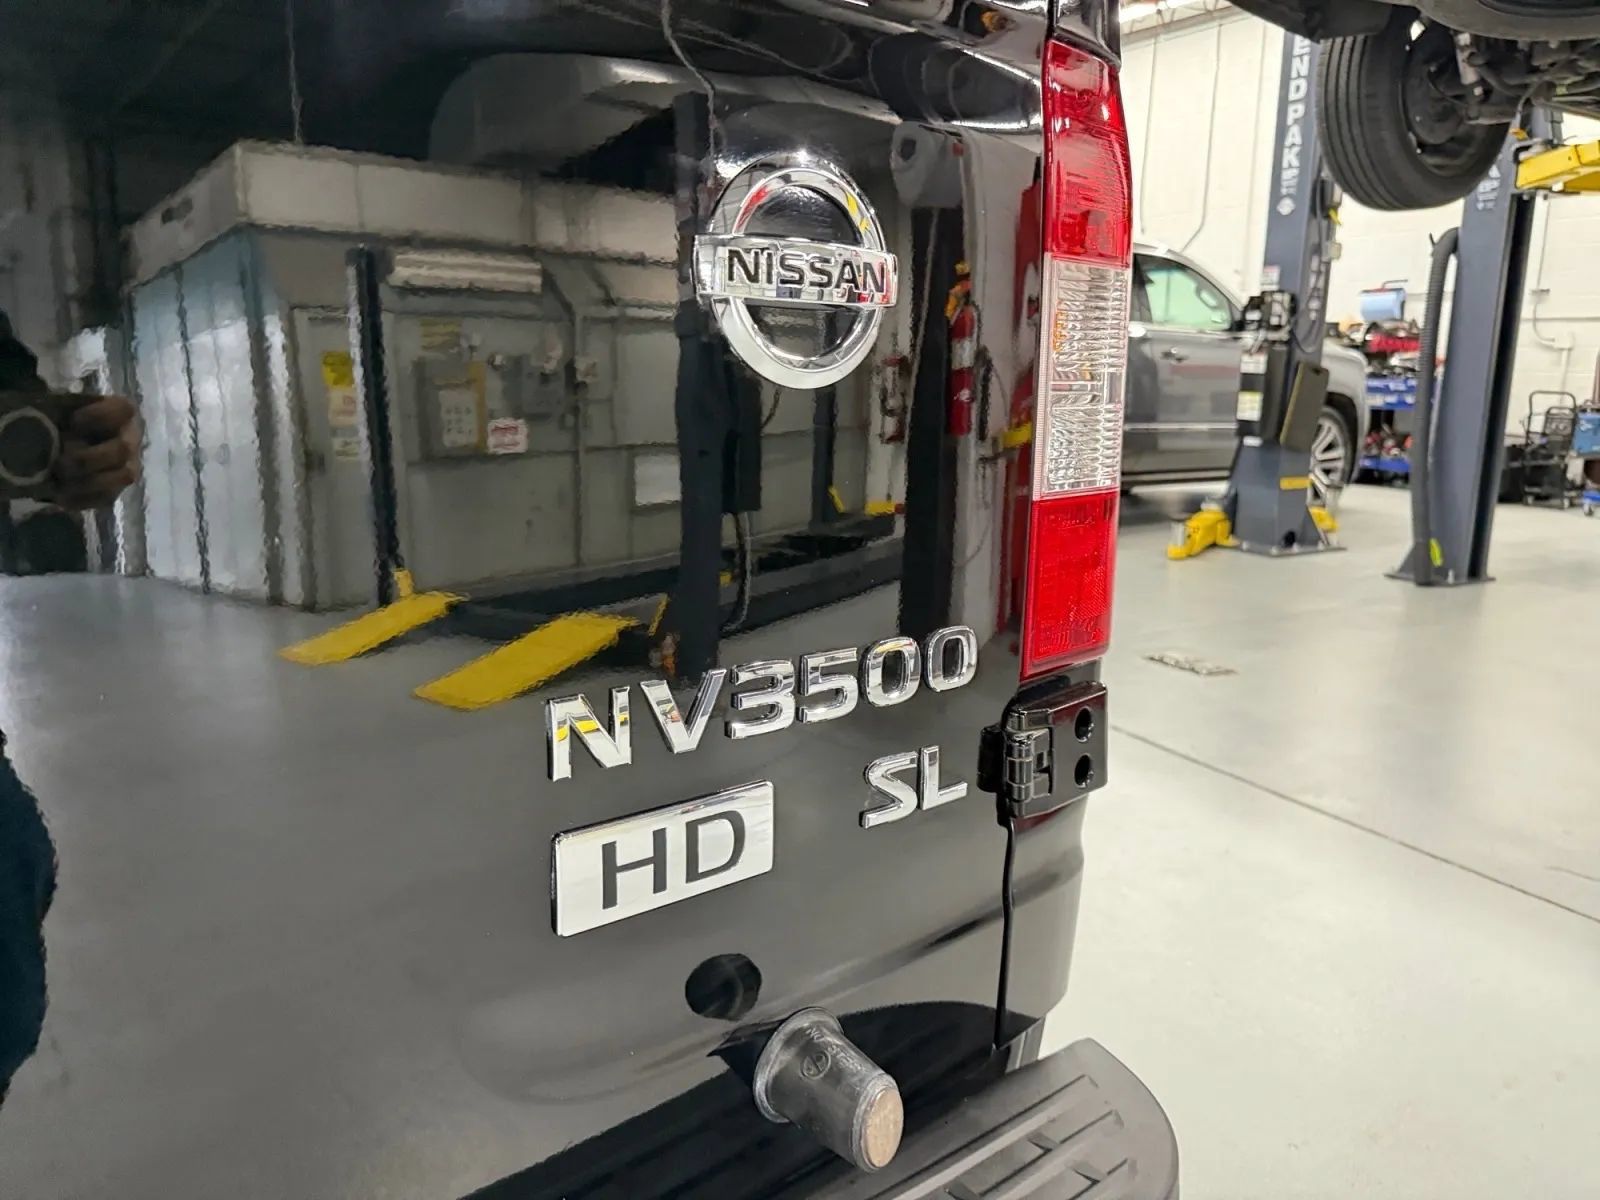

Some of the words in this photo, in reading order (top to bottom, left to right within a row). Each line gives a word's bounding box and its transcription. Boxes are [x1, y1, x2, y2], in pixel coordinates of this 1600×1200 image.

[727, 248, 886, 294] NISSAN
[546, 625, 979, 782] NV3500
[859, 744, 969, 830] SL
[601, 809, 746, 910] HD
